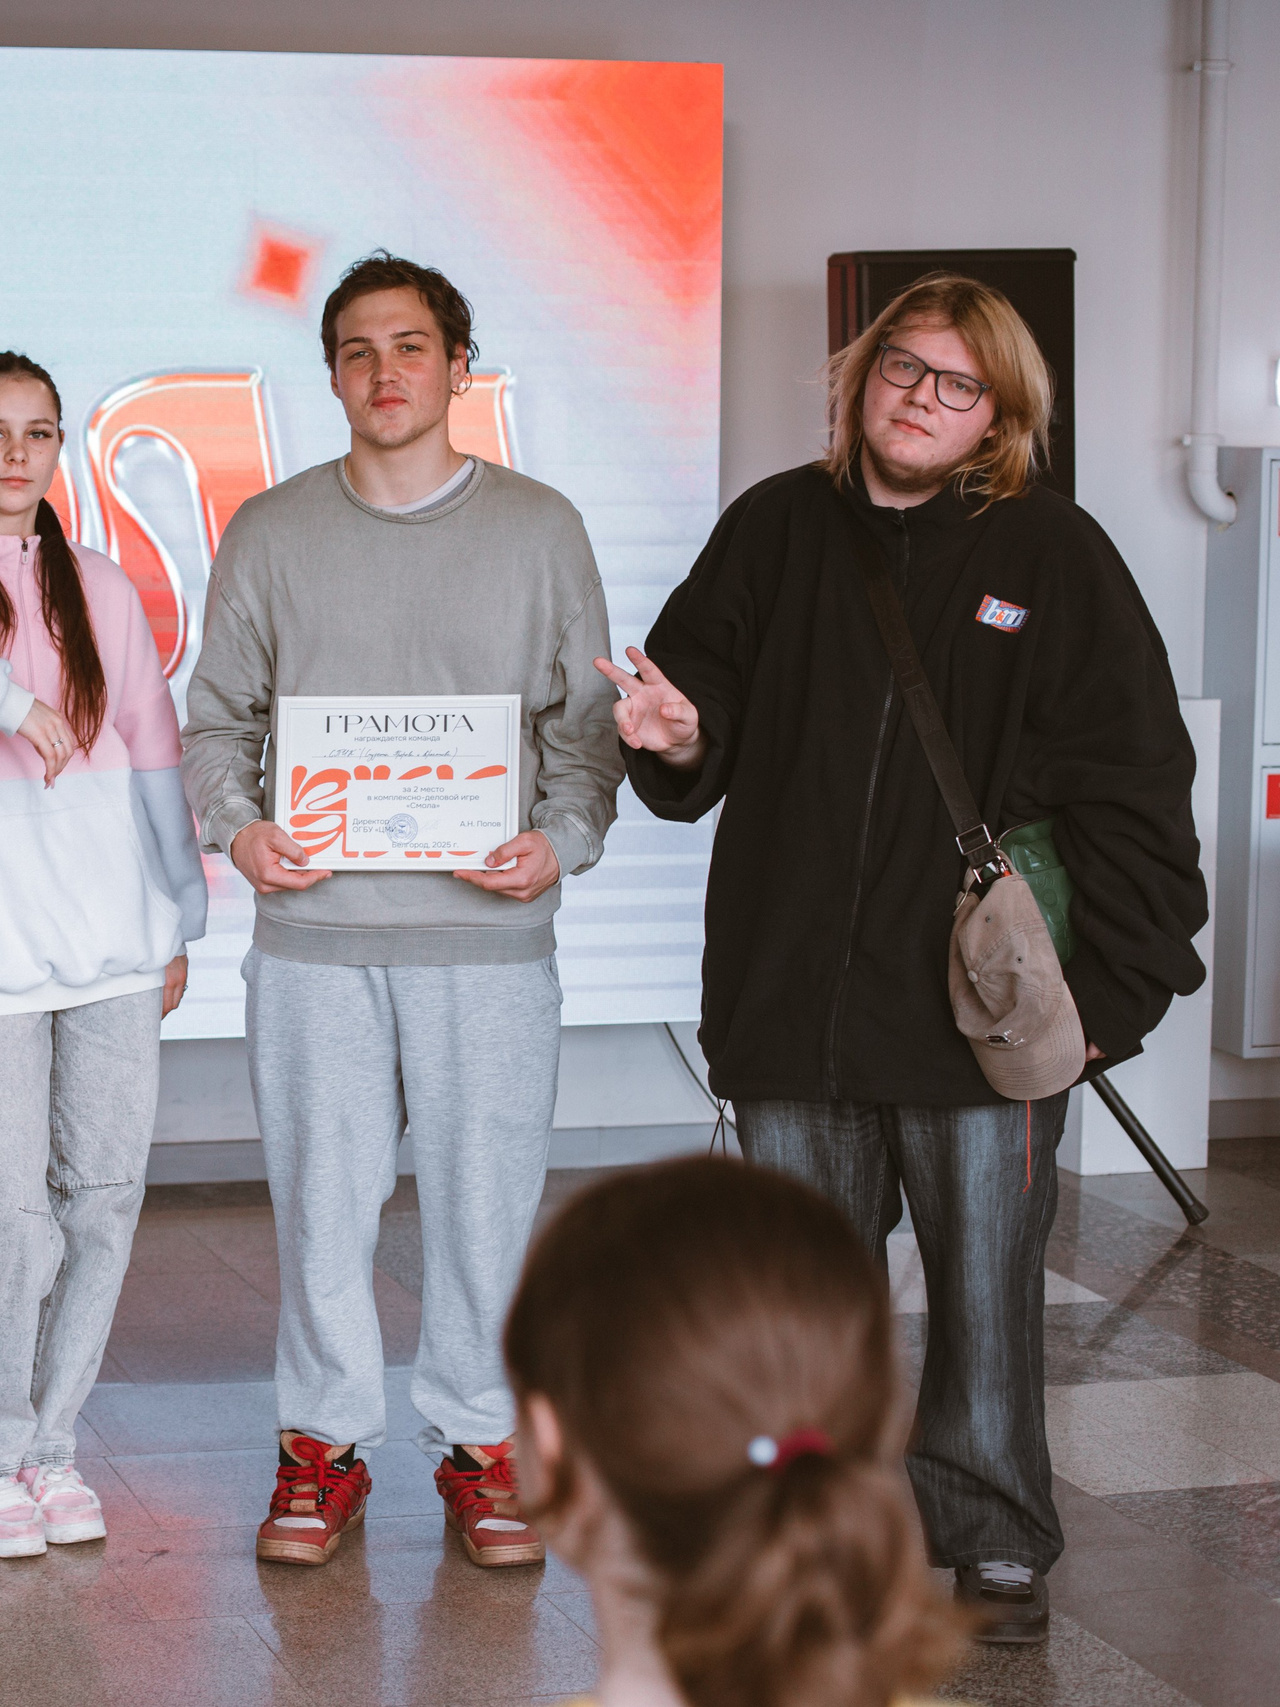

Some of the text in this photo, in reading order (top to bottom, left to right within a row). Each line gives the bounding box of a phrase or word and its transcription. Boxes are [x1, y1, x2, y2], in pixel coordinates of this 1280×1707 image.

[325, 713, 474, 734] ГРАМОТА
[353, 735, 441, 743] награждается команда
[413, 785, 419, 793] 2
[373, 793, 459, 803] комплексно-деловой
[460, 794, 480, 803] игре
[406, 801, 441, 809] «Смола»
[459, 820, 475, 828] А.Н.
[476, 820, 502, 828] Попов
[391, 841, 431, 849] Белгород,
[431, 841, 452, 849] 2025
